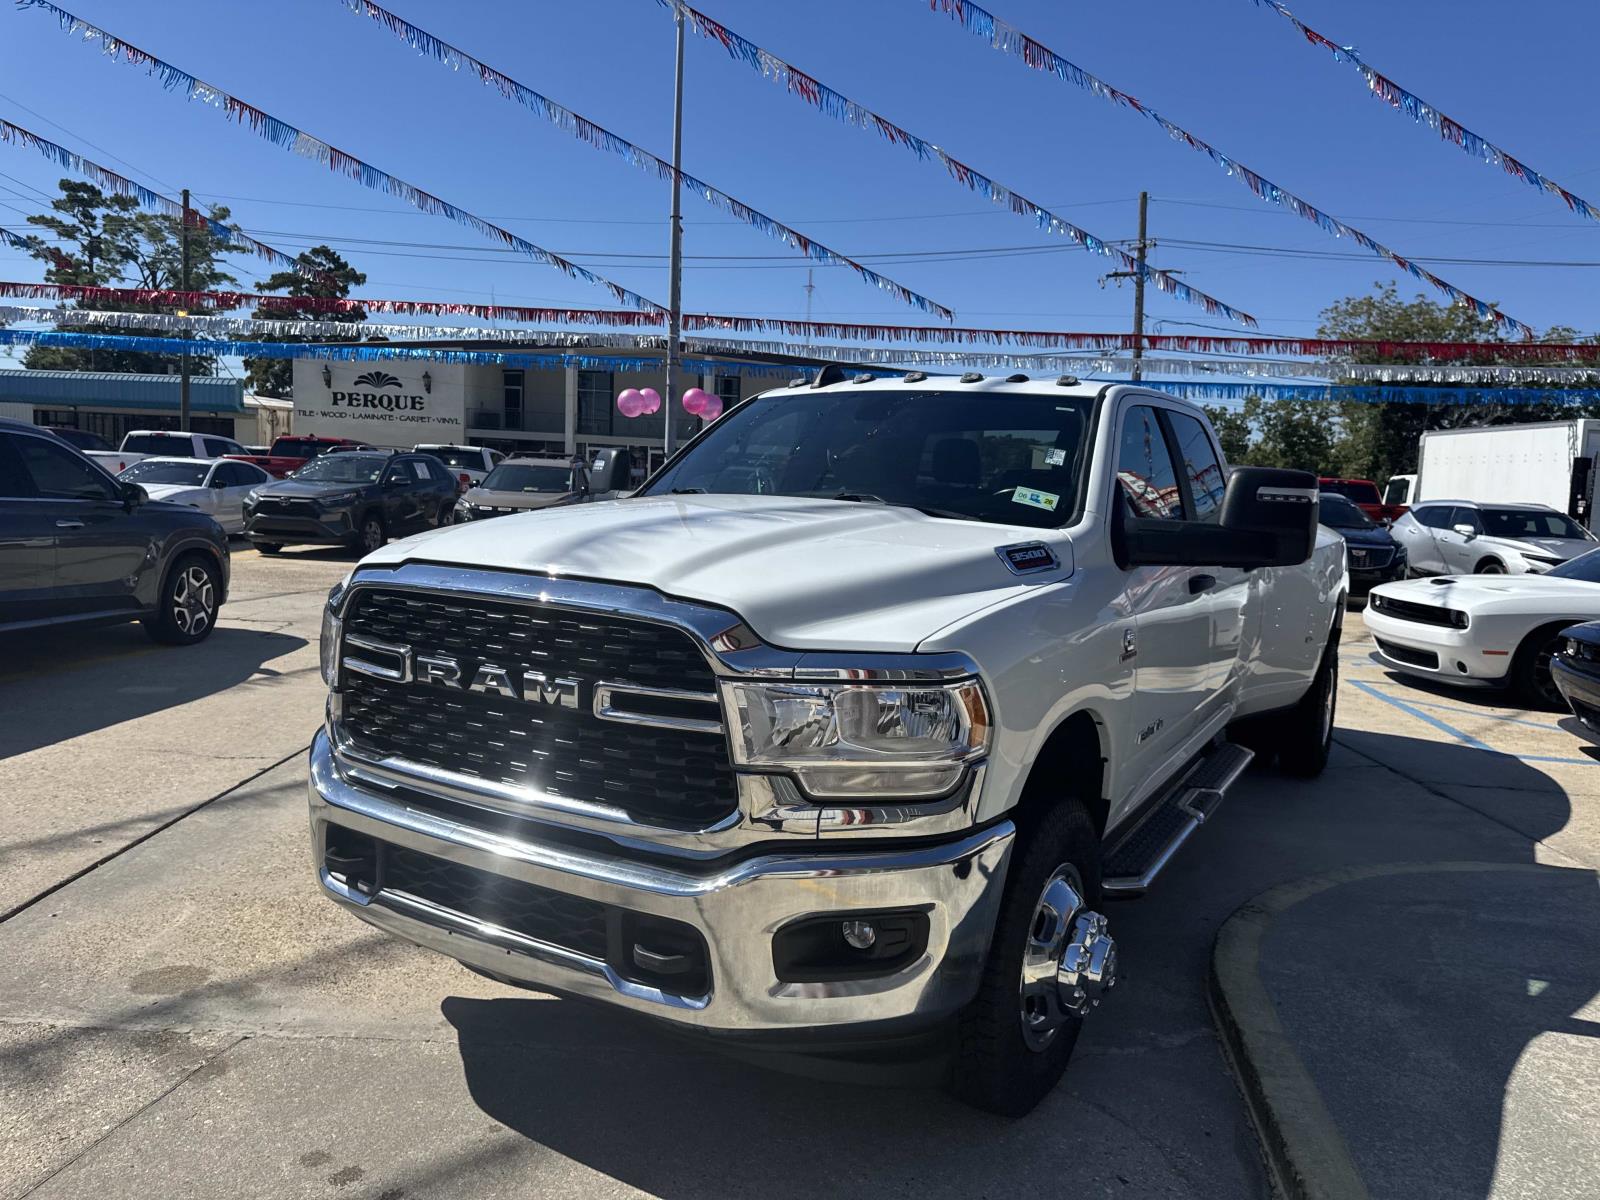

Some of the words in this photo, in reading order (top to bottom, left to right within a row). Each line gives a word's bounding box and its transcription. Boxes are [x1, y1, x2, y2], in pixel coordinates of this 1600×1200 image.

[332, 391, 424, 412] PERQUE
[297, 409, 315, 417] TILE
[320, 410, 347, 419] WOOD
[352, 412, 395, 421] LAMINATE
[399, 414, 433, 424] CARPET
[436, 416, 461, 425] VINYL
[1011, 549, 1047, 562] 3500
[417, 655, 579, 709] RAM
